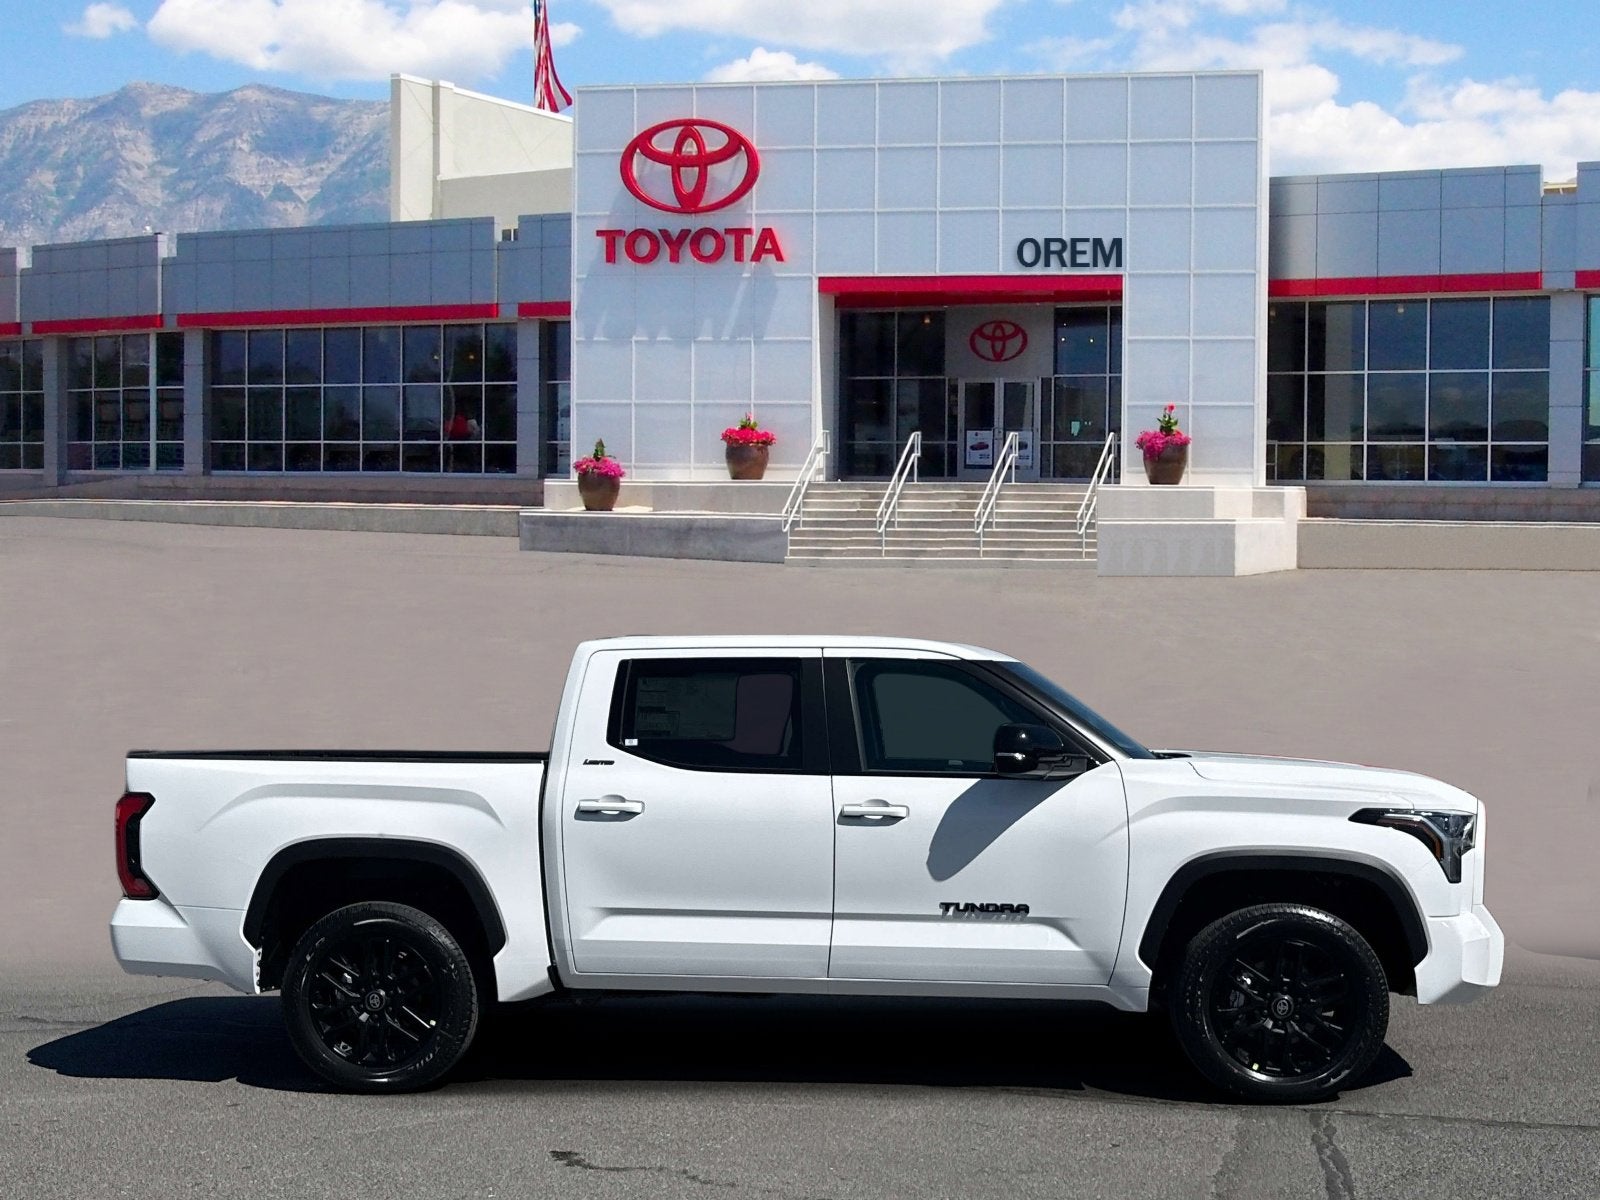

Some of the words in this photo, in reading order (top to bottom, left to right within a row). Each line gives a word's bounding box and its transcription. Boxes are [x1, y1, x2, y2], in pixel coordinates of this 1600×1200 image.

[596, 227, 784, 264] TOYOTA
[1017, 238, 1123, 268] OREM
[939, 902, 1030, 914] TUNDRA
